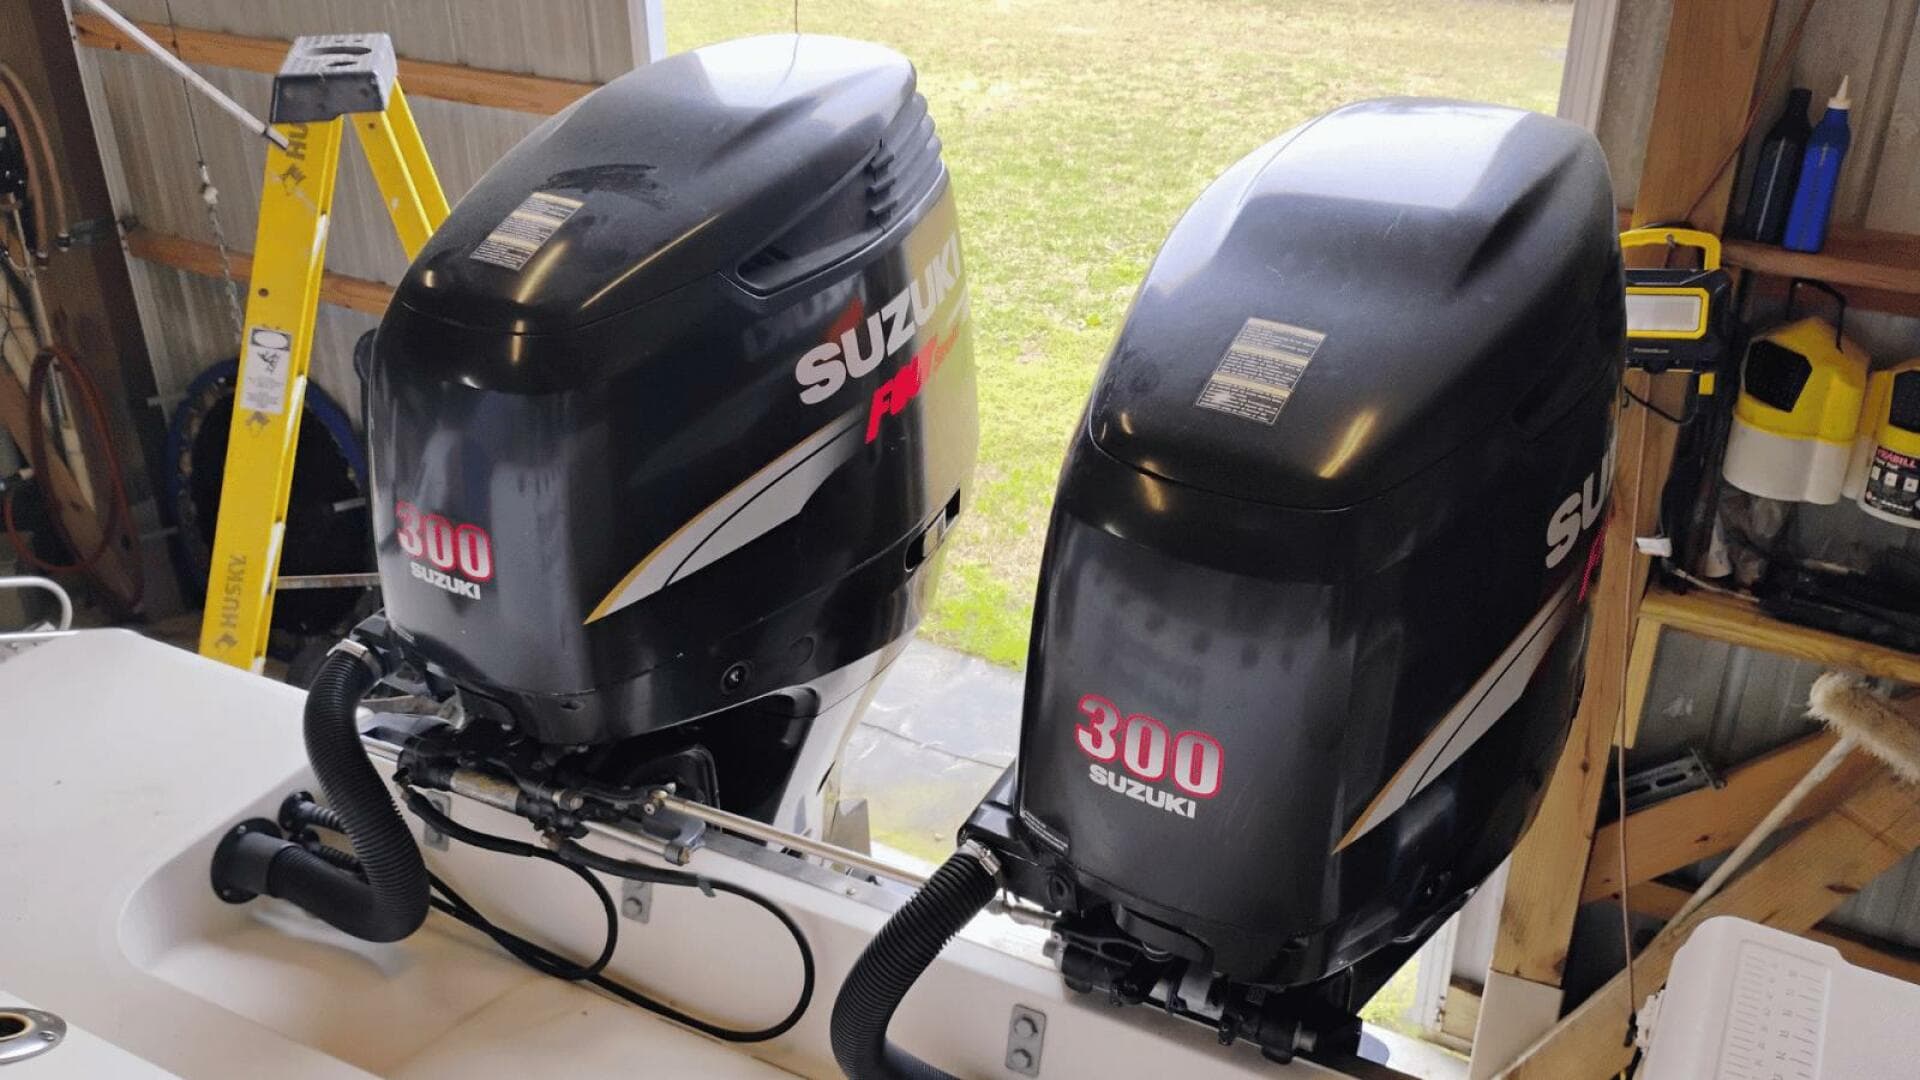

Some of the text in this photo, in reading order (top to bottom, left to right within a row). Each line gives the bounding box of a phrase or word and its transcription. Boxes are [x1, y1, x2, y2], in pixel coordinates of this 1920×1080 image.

[795, 232, 961, 405] SUZUKI
[395, 498, 492, 583] 300
[220, 555, 247, 629] HUSKY
[410, 561, 481, 600] SUZUKI
[1075, 693, 1225, 800] 300
[1089, 764, 1197, 819] SUZUKI
